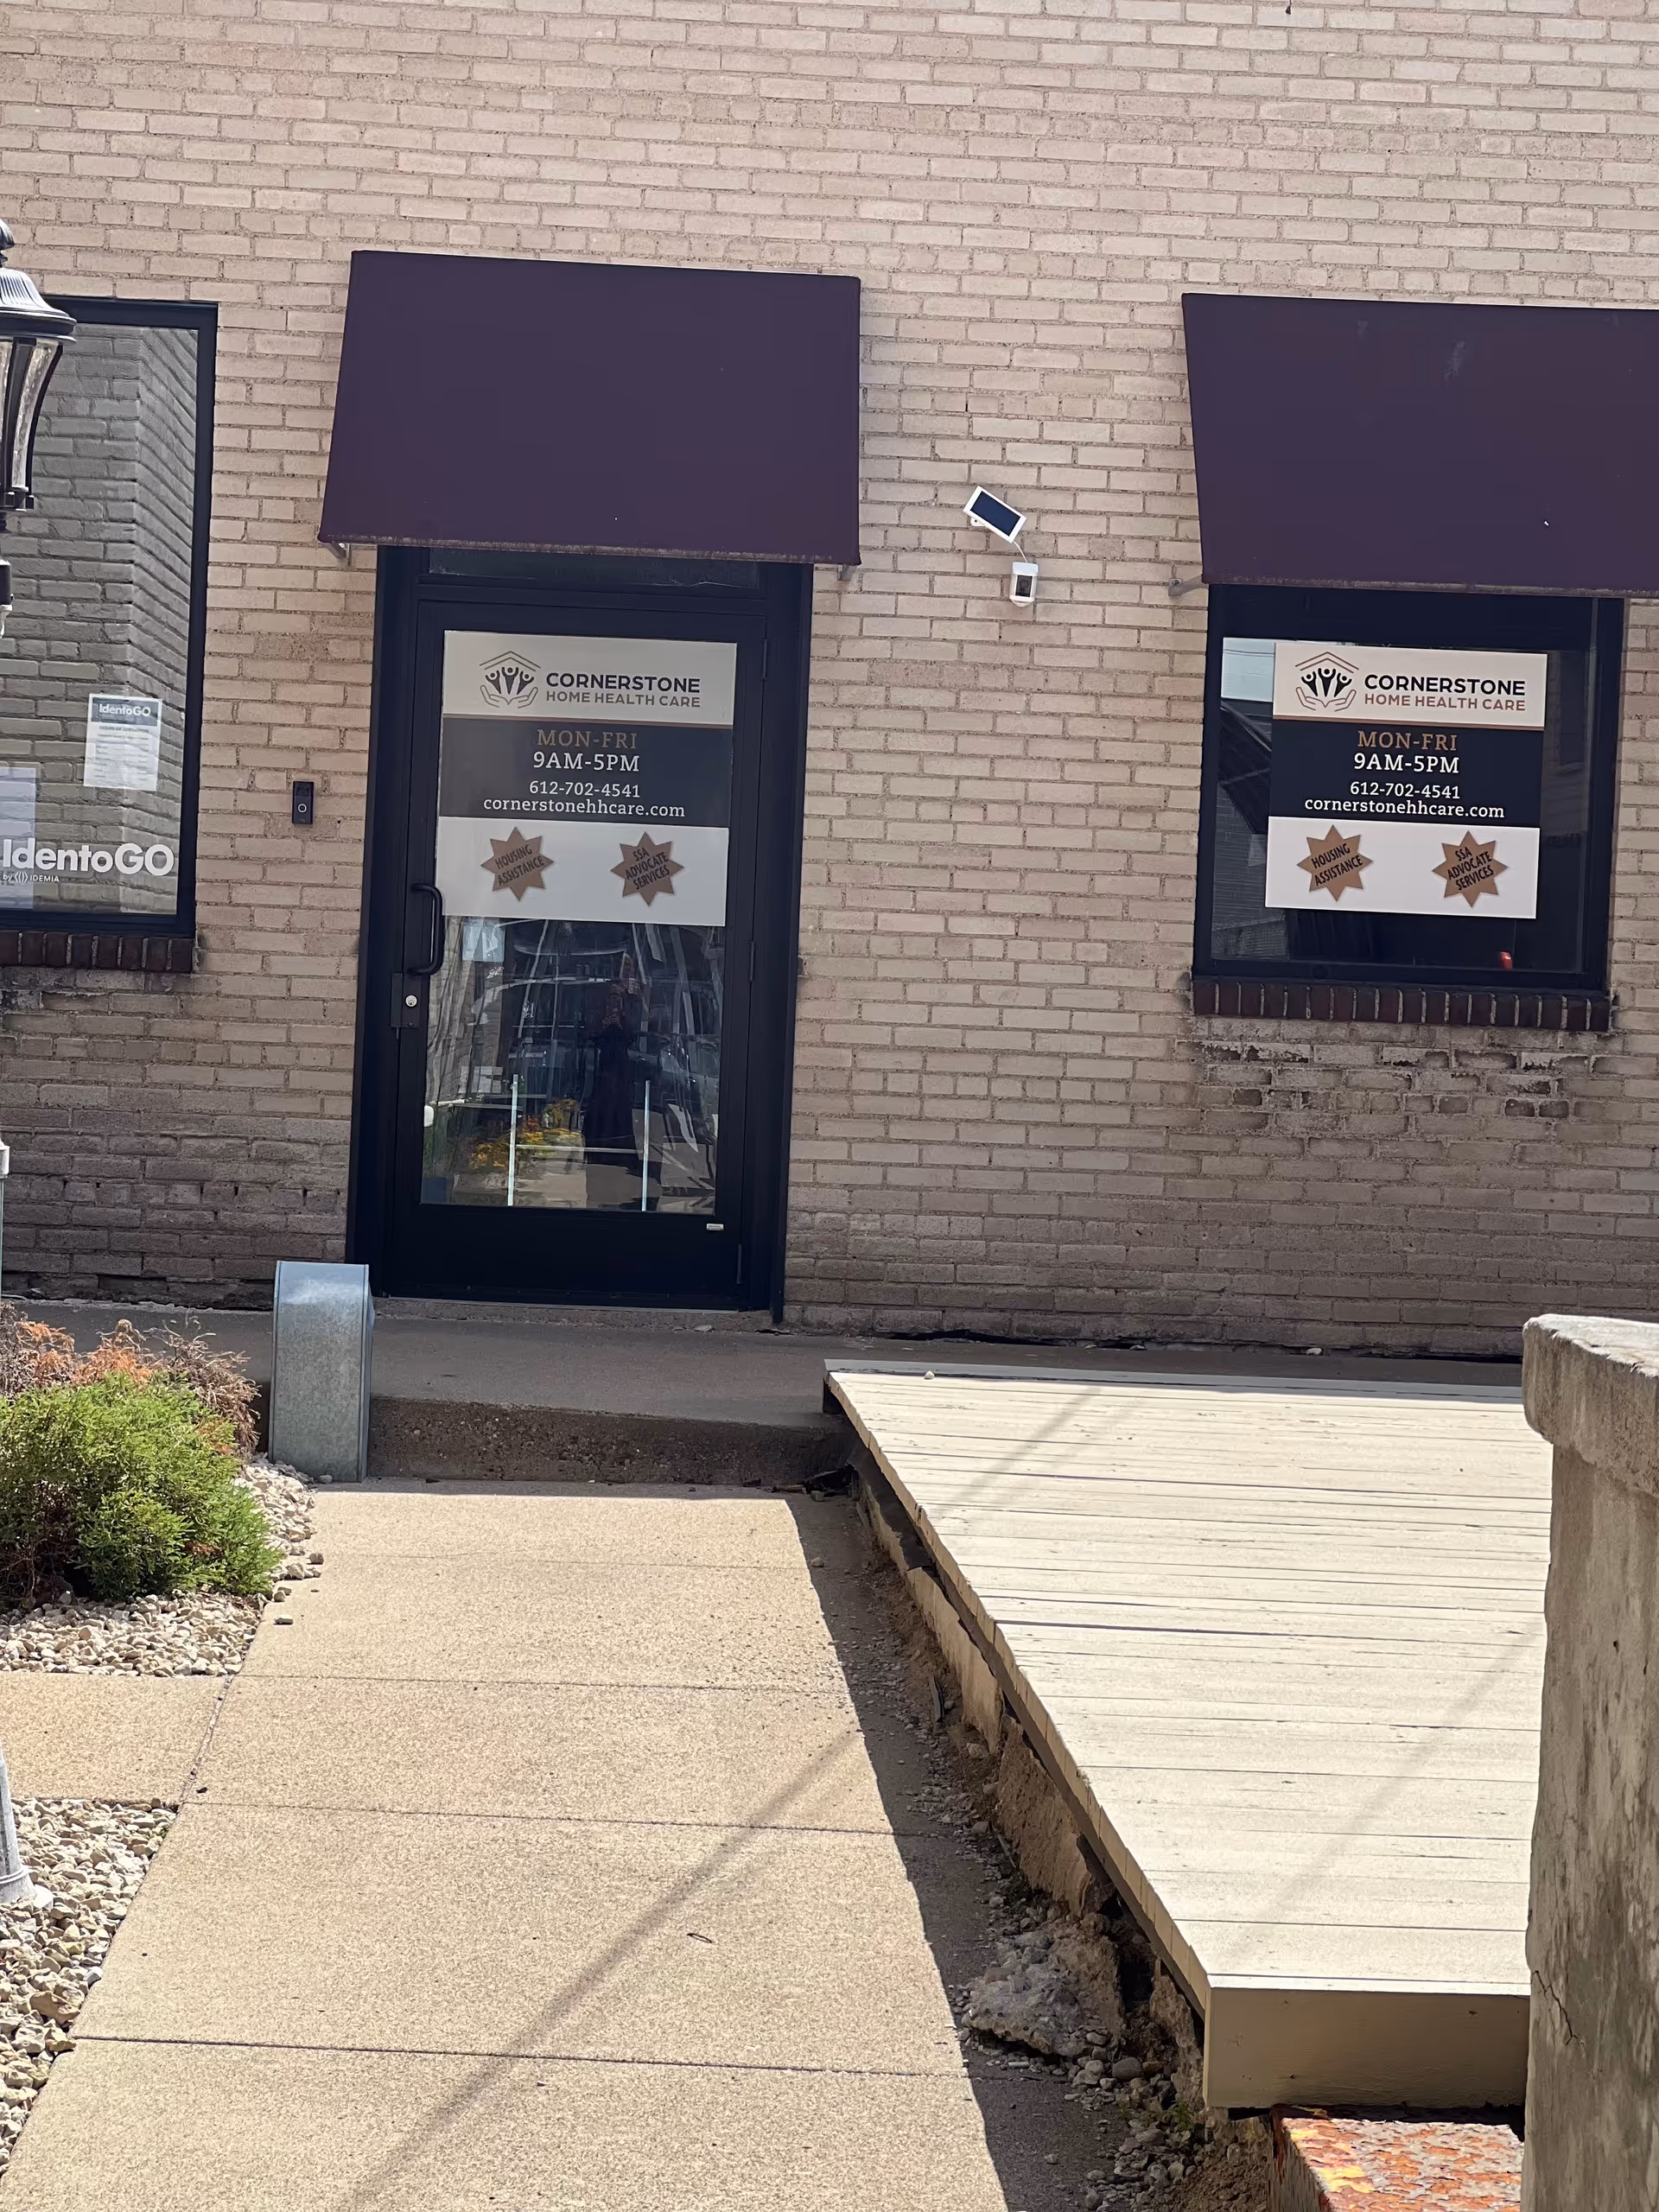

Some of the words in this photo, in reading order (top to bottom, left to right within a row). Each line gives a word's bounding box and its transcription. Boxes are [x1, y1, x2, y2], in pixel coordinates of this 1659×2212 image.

[546, 672, 701, 693] CORNERSTONE
[1364, 674, 1526, 696] CORNERSTONE
[546, 690, 591, 703] HOME
[594, 692, 655, 706] HEALTH
[658, 695, 701, 708] CARE
[1364, 693, 1411, 707] HOME
[1414, 696, 1478, 709] HEALTH
[1482, 698, 1526, 711] CARE
[99, 703, 151, 717] IdentoGO
[537, 729, 638, 749] MON-FRI
[1357, 730, 1458, 751] MON-FRI
[532, 751, 639, 772] 9AM-5PM
[1353, 753, 1459, 774] 9AM-5PM
[529, 780, 640, 798] 612-702-4541
[1350, 781, 1460, 799] 612-702-4541
[483, 798, 685, 817] cornerstonehhcare.com
[1305, 798, 1504, 818] cornerstonehhcare.com
[3, 837, 175, 876] IdentoGO
[495, 844, 532, 869] HOUSING
[632, 847, 650, 862] SSA
[1311, 842, 1351, 869] HOUSING
[1455, 847, 1472, 861] SSA
[497, 855, 545, 886] ASSISTANCE
[625, 851, 669, 880] ADVOCATE
[1314, 855, 1363, 887] ASSISTANCE
[1447, 851, 1492, 880] ADVOCATE
[3, 873, 13, 882] by
[29, 874, 60, 883] IDEMIA
[632, 864, 671, 890] SERVICES
[1455, 864, 1494, 891] SERVICES
